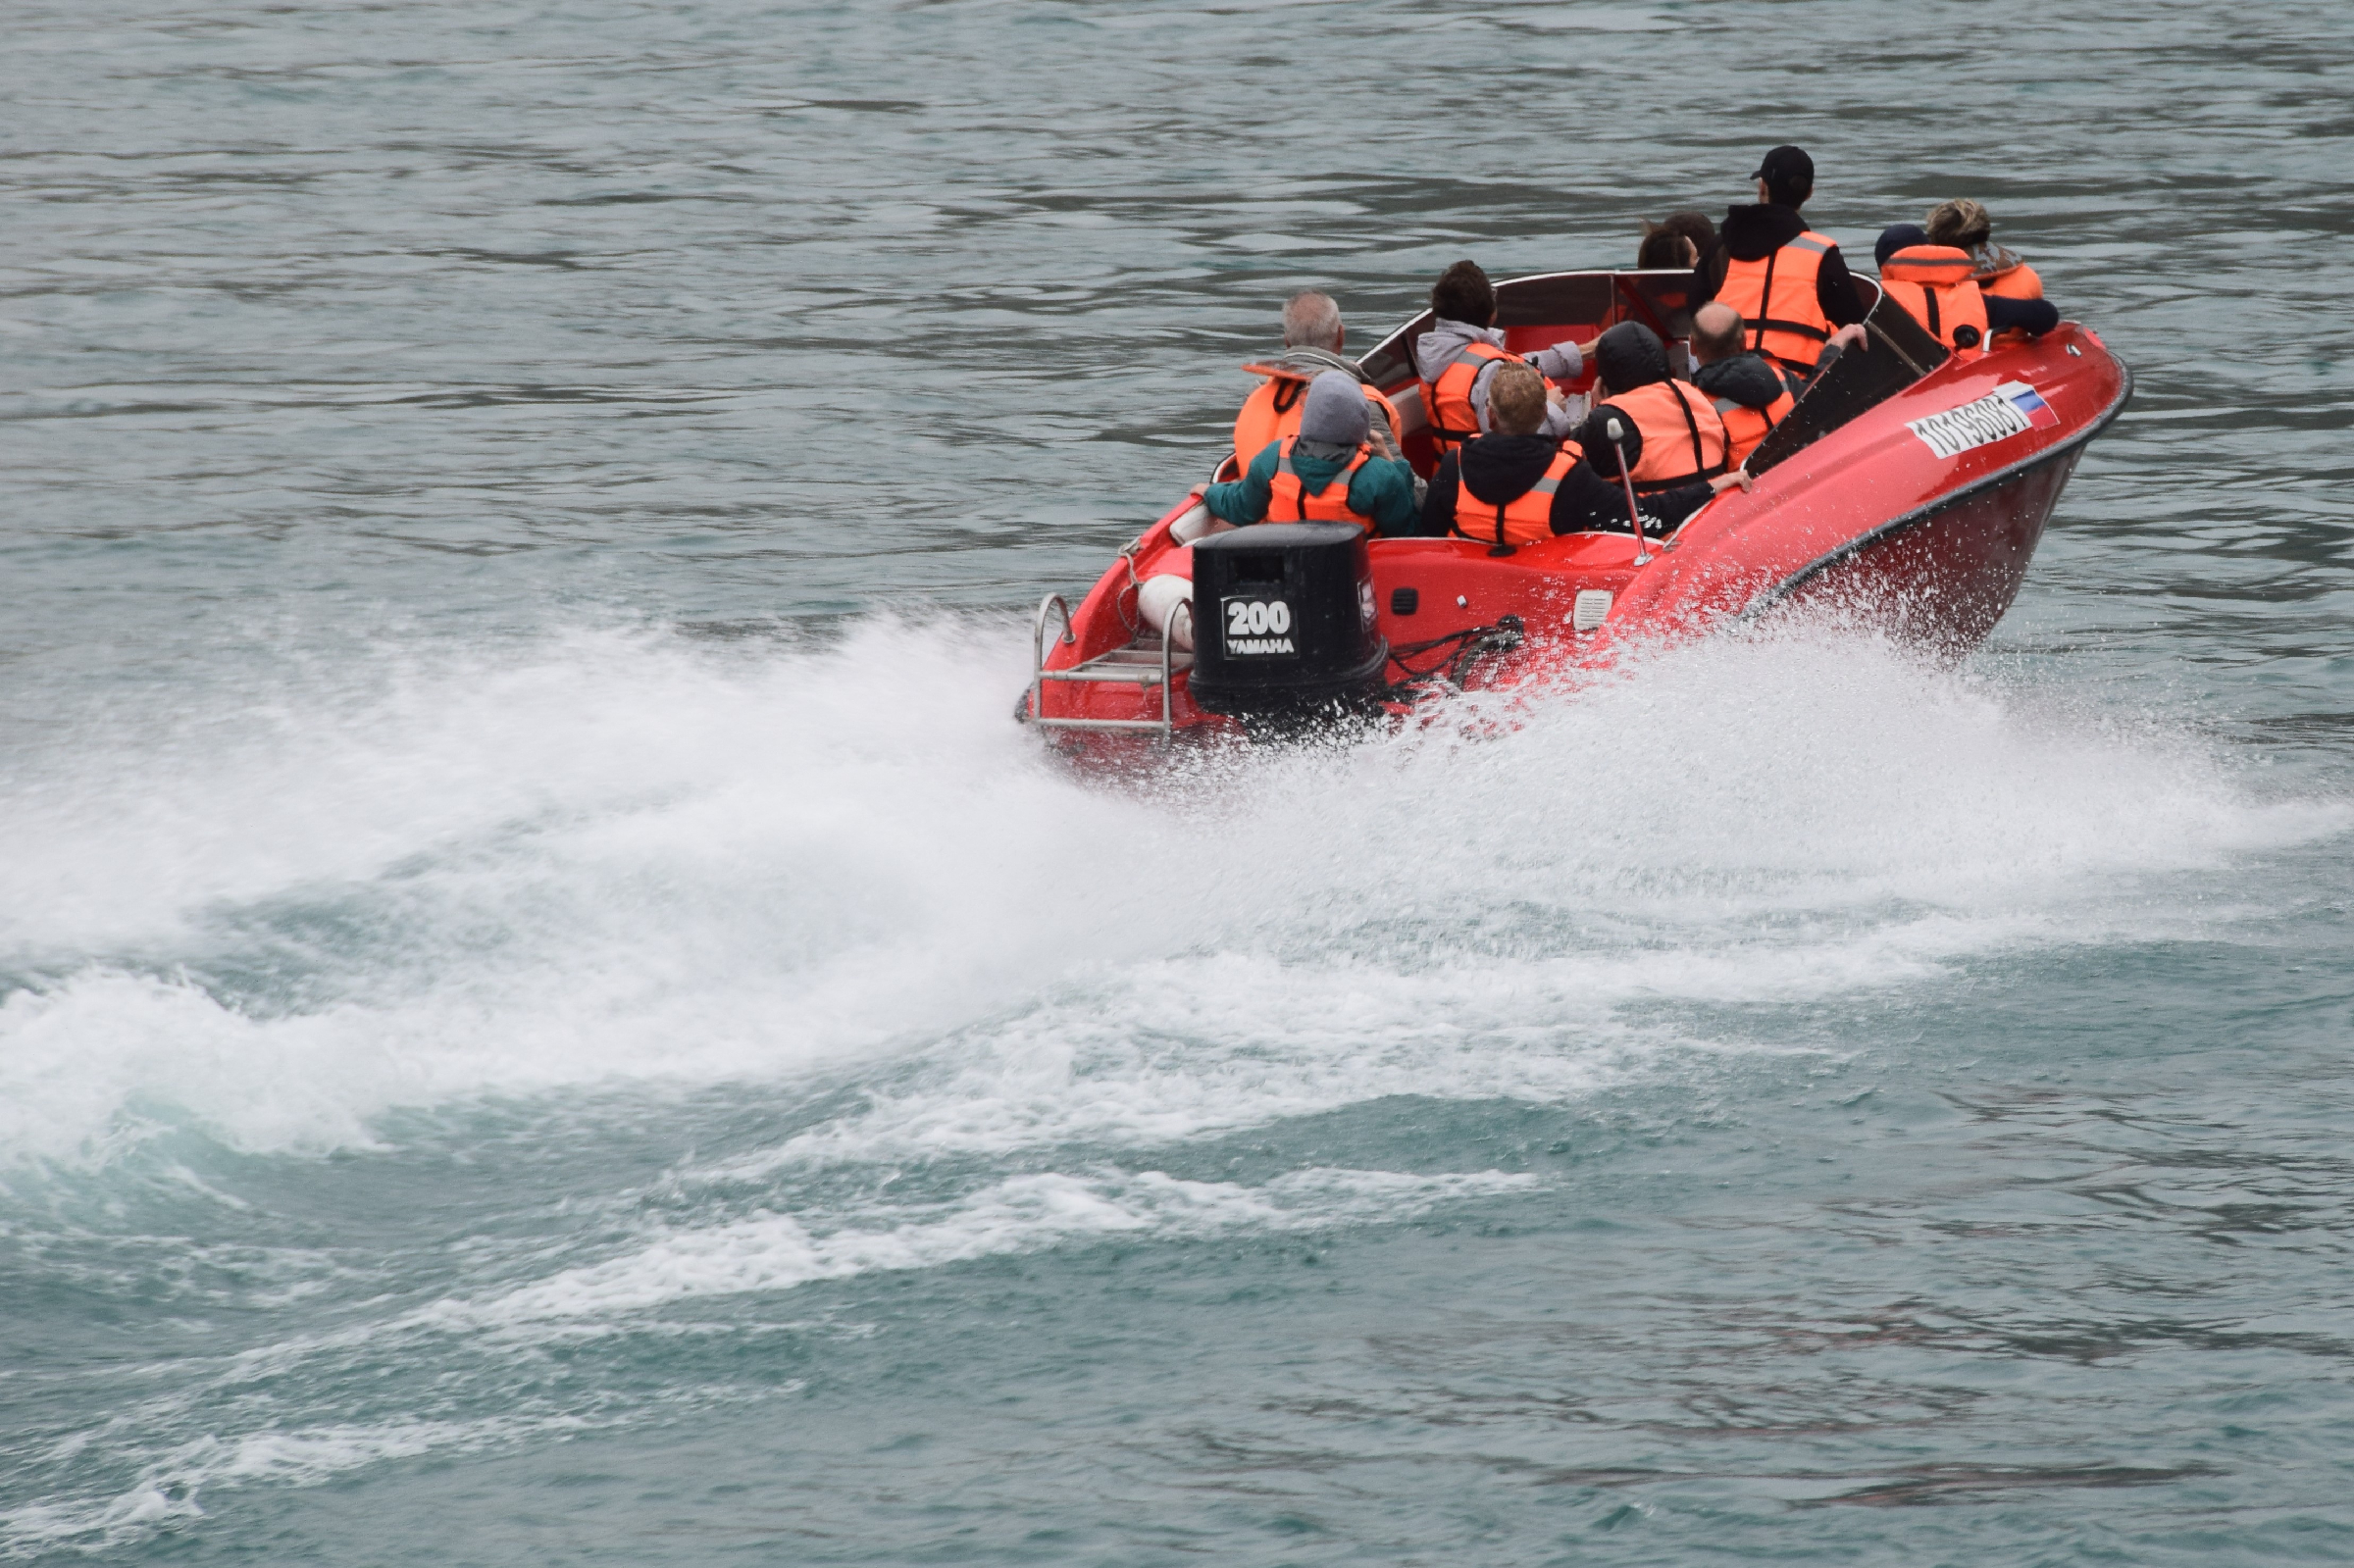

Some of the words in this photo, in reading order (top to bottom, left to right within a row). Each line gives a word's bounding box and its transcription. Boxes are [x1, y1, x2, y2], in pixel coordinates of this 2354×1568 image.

[1914, 394, 2026, 455] 10196081
[1228, 601, 1291, 635] 200
[1227, 638, 1295, 654] YAMAHA
